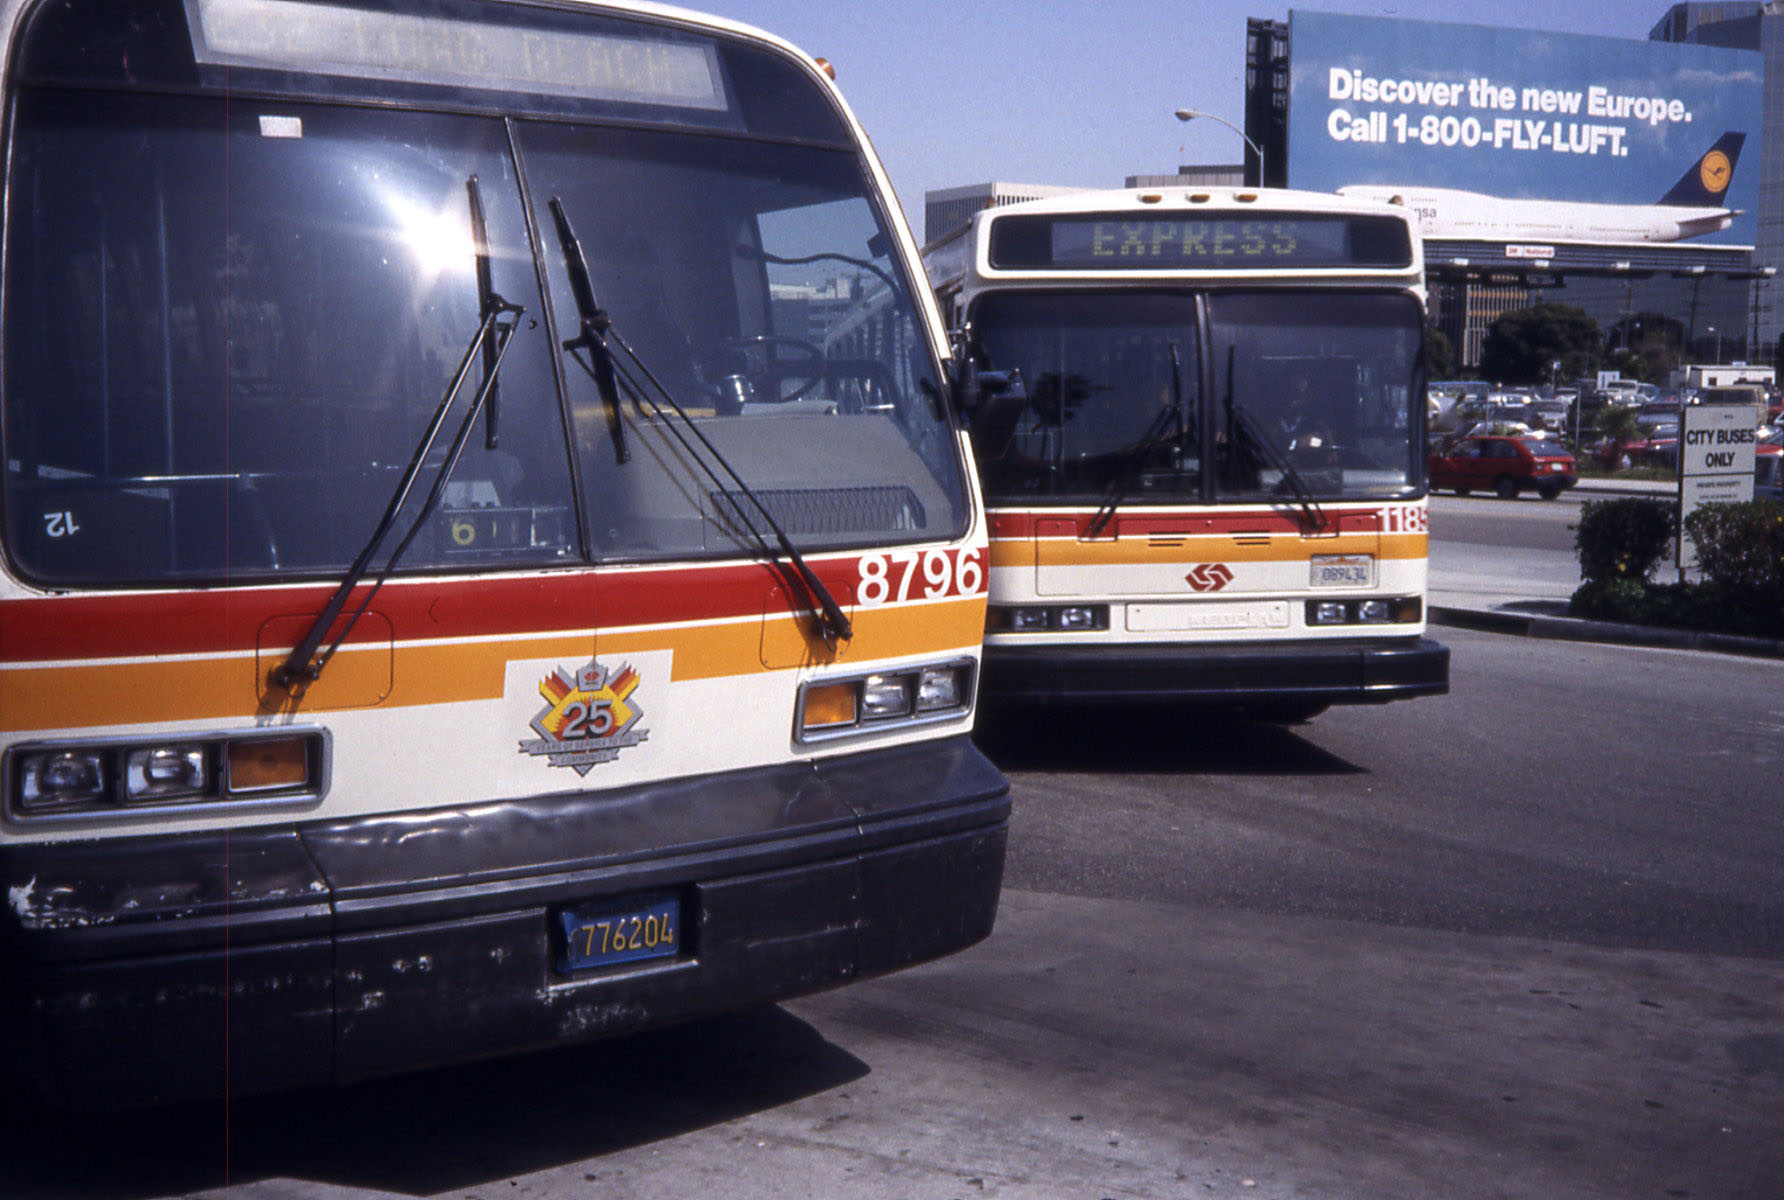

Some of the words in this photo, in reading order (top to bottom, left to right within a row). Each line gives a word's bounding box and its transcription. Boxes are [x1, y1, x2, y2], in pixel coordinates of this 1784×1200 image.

[522, 33, 672, 93] BEACH
[1329, 68, 1464, 108] Discover
[1469, 78, 1516, 110] the
[1522, 87, 1582, 115] new
[1587, 86, 1692, 126] Europe.
[1328, 109, 1387, 143] Call
[1392, 116, 1628, 157] 1-800-FLY-LUFT.
[1093, 222, 1297, 256] EXPRESS
[1687, 429, 1715, 445] CITY
[1717, 428, 1755, 444] BUSES
[1705, 452, 1735, 468] ONLY
[44, 511, 80, 537] 12
[857, 547, 982, 608] 8796
[562, 699, 613, 738] 25
[581, 912, 674, 957] 776204
